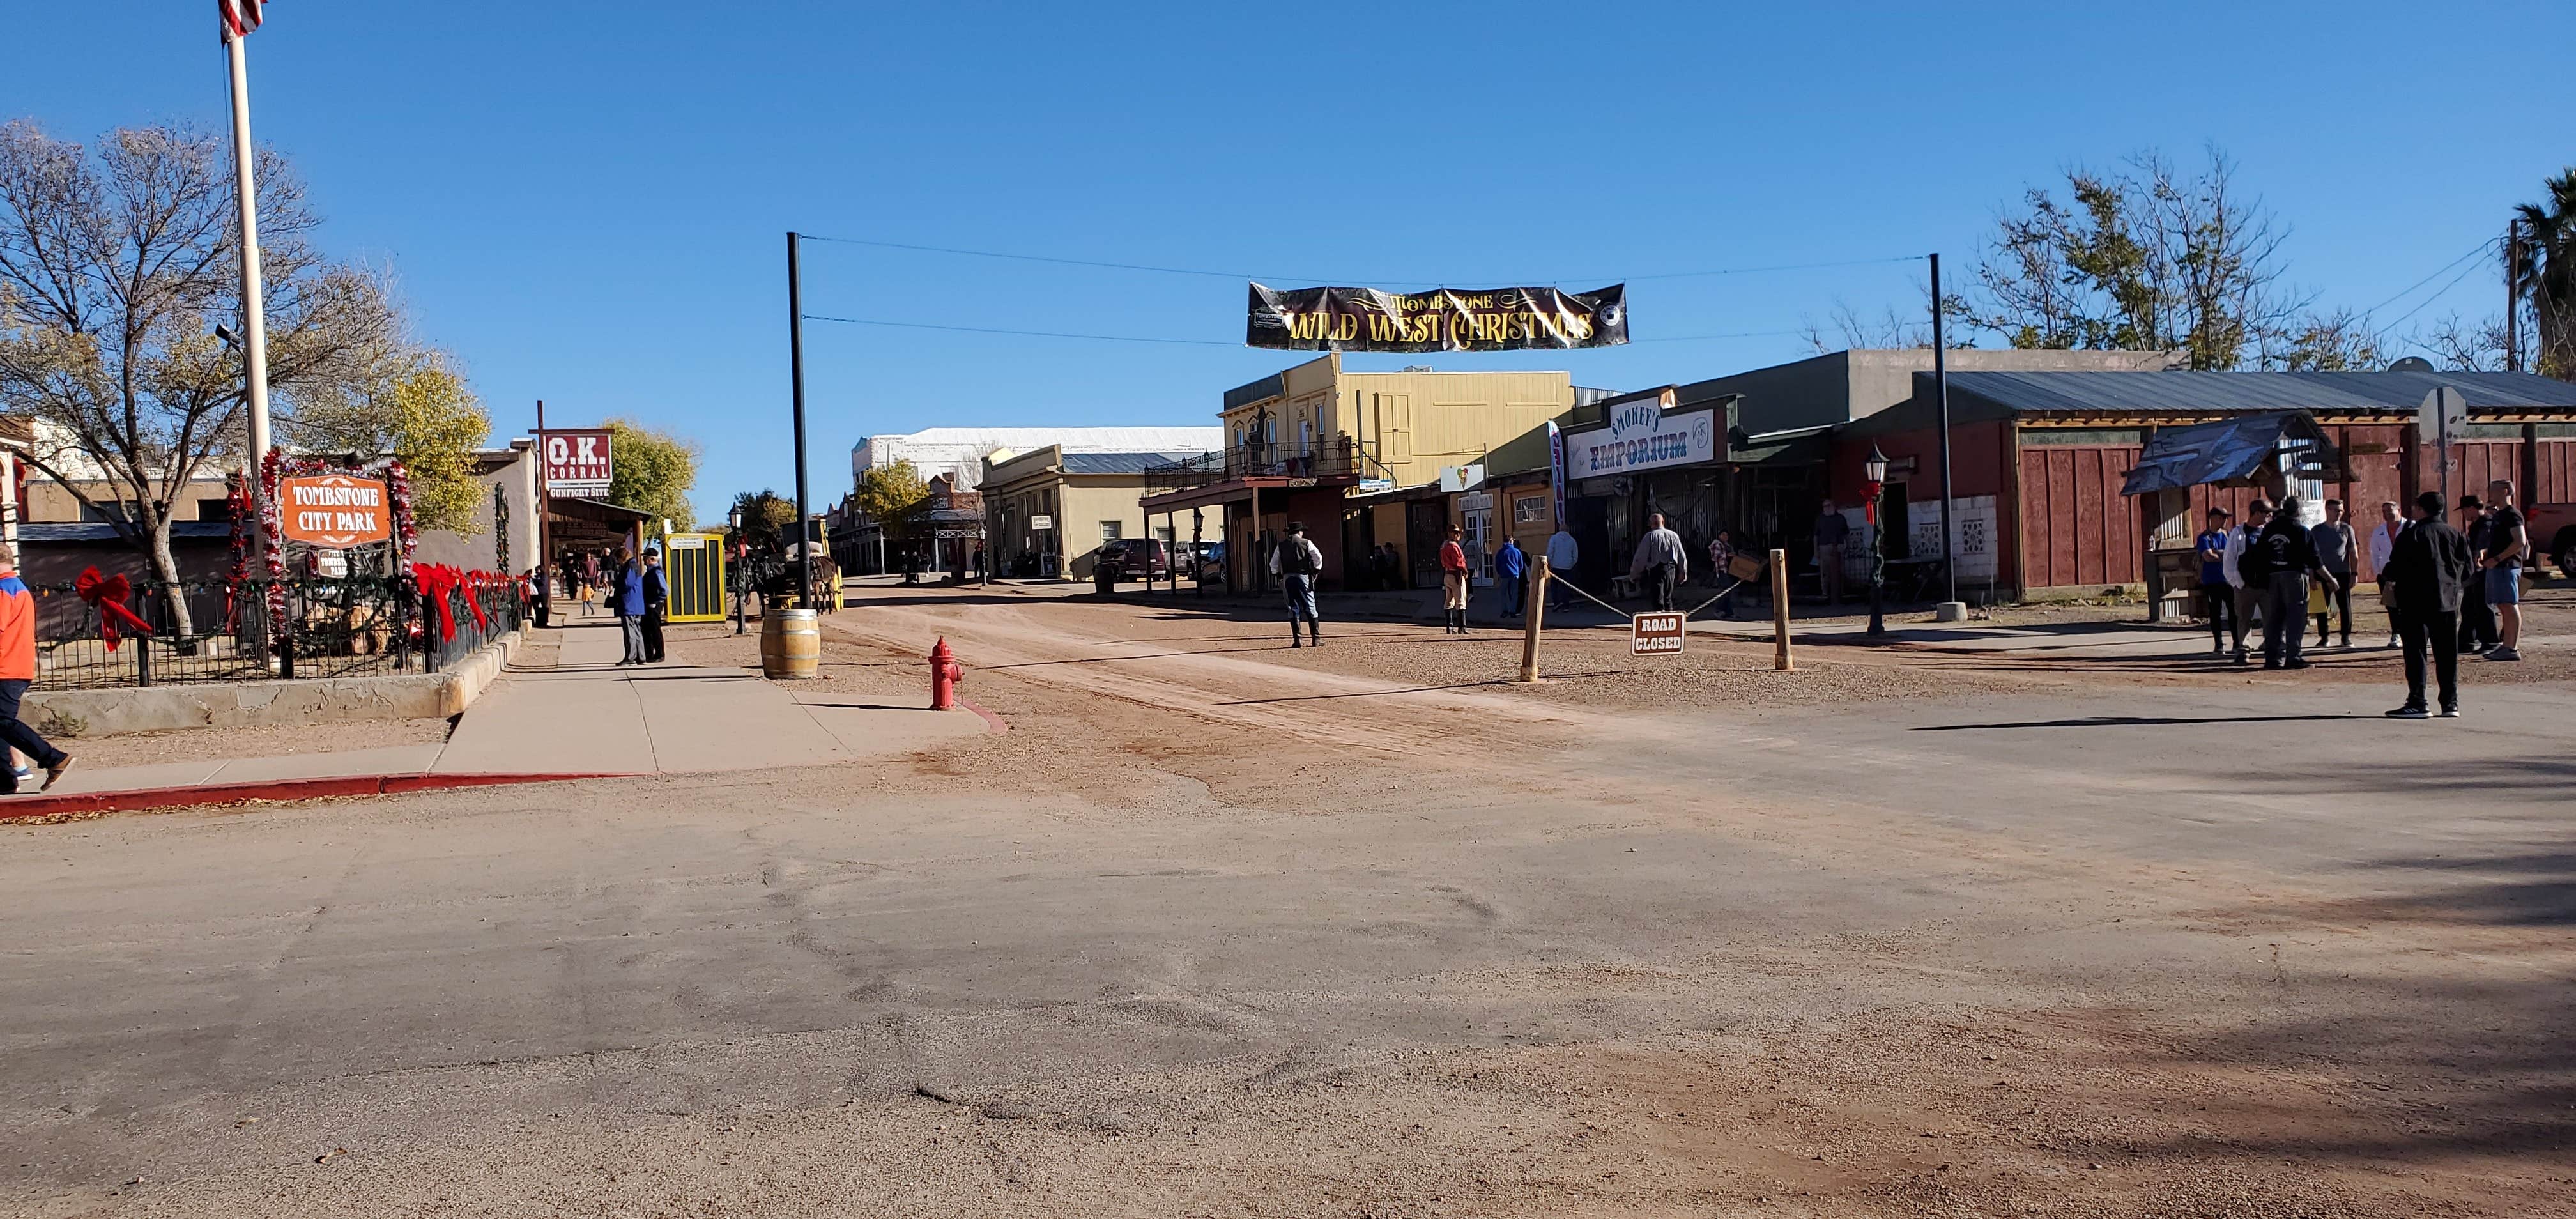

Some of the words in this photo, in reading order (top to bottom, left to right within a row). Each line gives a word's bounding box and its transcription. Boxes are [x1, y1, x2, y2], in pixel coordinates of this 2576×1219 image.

[1390, 295, 1494, 316] TOMBSTONE
[1289, 312, 1358, 341] WILD
[1367, 314, 1443, 342] WEST
[1450, 310, 1594, 349] CHRISTMAS
[1611, 406, 1660, 440] SMOKEY'S
[548, 437, 606, 465] O.K.
[1590, 431, 1687, 471] EMPORIUM
[550, 466, 608, 479] CORRAL
[293, 486, 379, 507] TOMBSTONE
[550, 488, 590, 498] GUNFIGHT
[590, 487, 610, 497] SITE
[298, 511, 332, 531] CITY
[337, 512, 378, 531] PARK
[1641, 618, 1677, 632] ROAD
[1636, 636, 1681, 650] CLOSED
